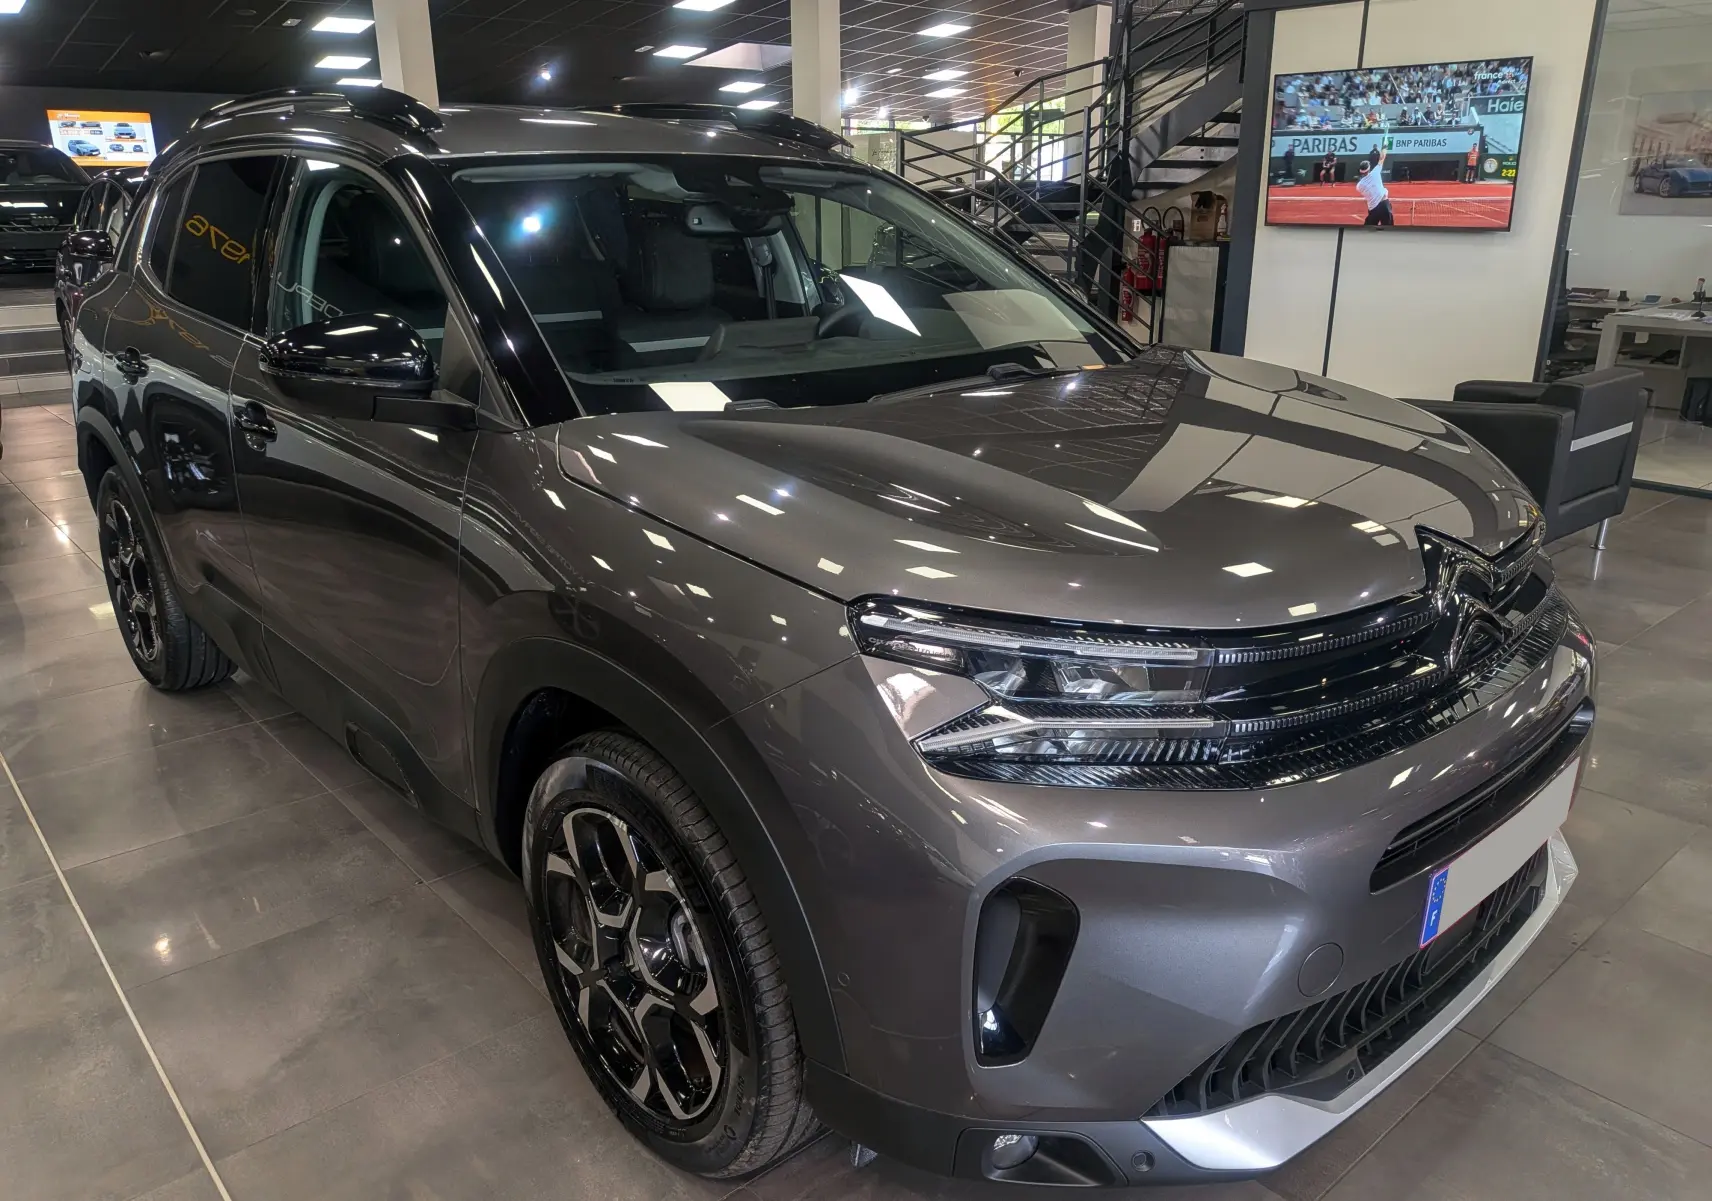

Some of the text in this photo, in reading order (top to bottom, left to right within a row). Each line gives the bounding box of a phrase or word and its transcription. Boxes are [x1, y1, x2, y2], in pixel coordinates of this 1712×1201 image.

[1474, 71, 1503, 80] france
[1487, 97, 1524, 113] Haie
[1293, 136, 1358, 153] PARIBAS
[1395, 138, 1448, 148] BNP PARIBAS
[1430, 909, 1438, 926] F
